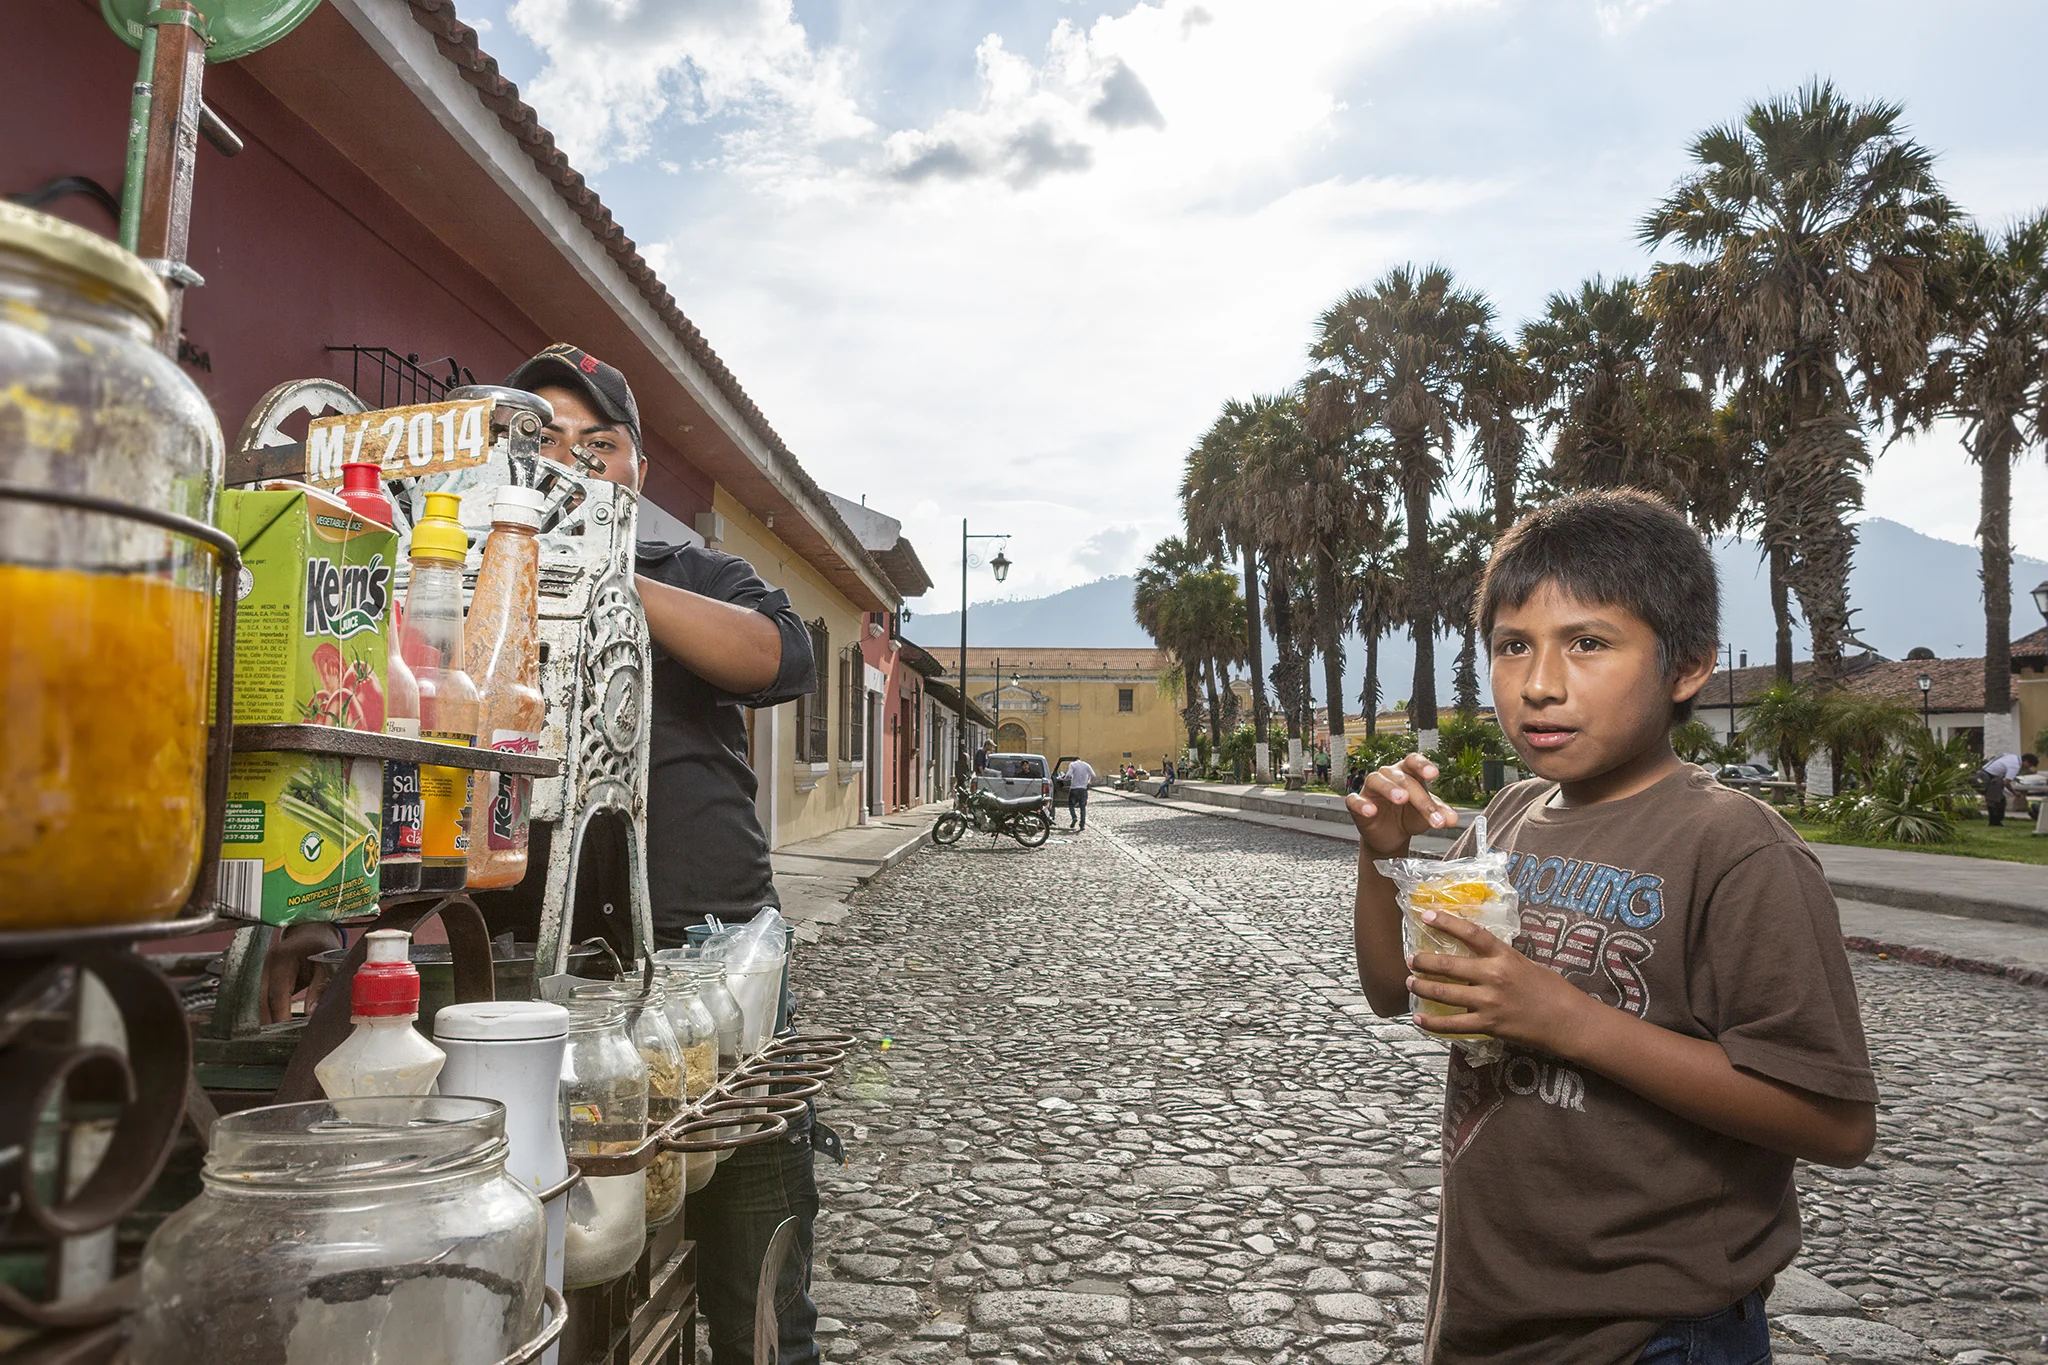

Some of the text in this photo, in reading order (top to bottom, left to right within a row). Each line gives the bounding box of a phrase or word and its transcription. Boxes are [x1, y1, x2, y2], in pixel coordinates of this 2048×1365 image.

[380, 405, 485, 471] 2014
[316, 515, 346, 528] VEGETABLE
[304, 553, 391, 636] Kern's
[341, 615, 359, 632] JUICE
[392, 769, 419, 794] sal
[391, 802, 421, 830] ing
[494, 767, 513, 839] Kern
[287, 896, 301, 906] NO
[300, 889, 329, 905] ARTIFICIAL
